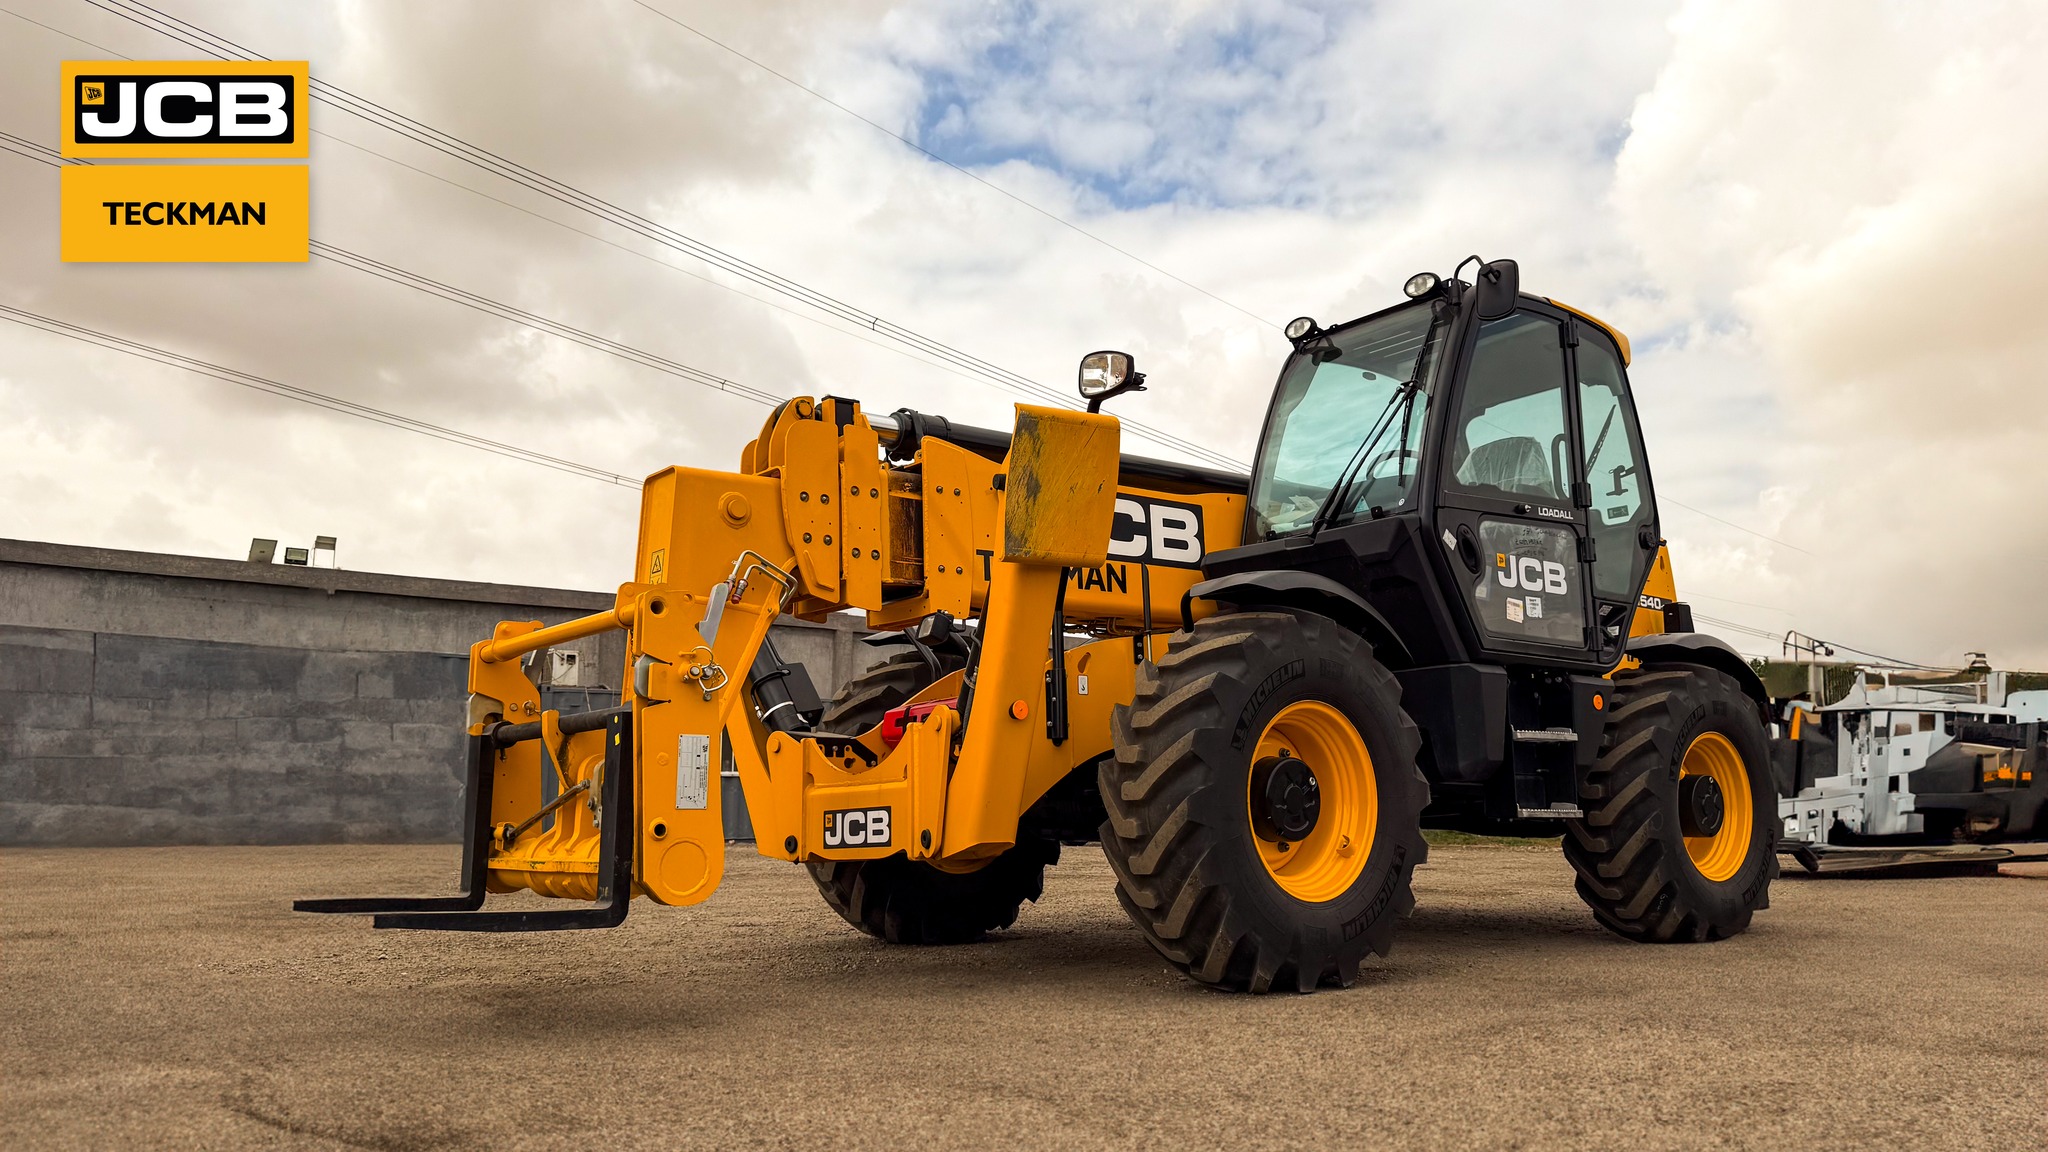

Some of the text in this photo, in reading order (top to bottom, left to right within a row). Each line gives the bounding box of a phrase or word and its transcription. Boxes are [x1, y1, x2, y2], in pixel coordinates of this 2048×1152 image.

[1106, 498, 1201, 564] CB
[1538, 507, 1574, 520] LOADALL
[1497, 554, 1568, 596] JCB
[1240, 659, 1305, 723] MICHELIN
[1672, 704, 1706, 764] MICHELIN
[825, 810, 890, 846] JCB
[1342, 865, 1400, 941] MICHELIN
